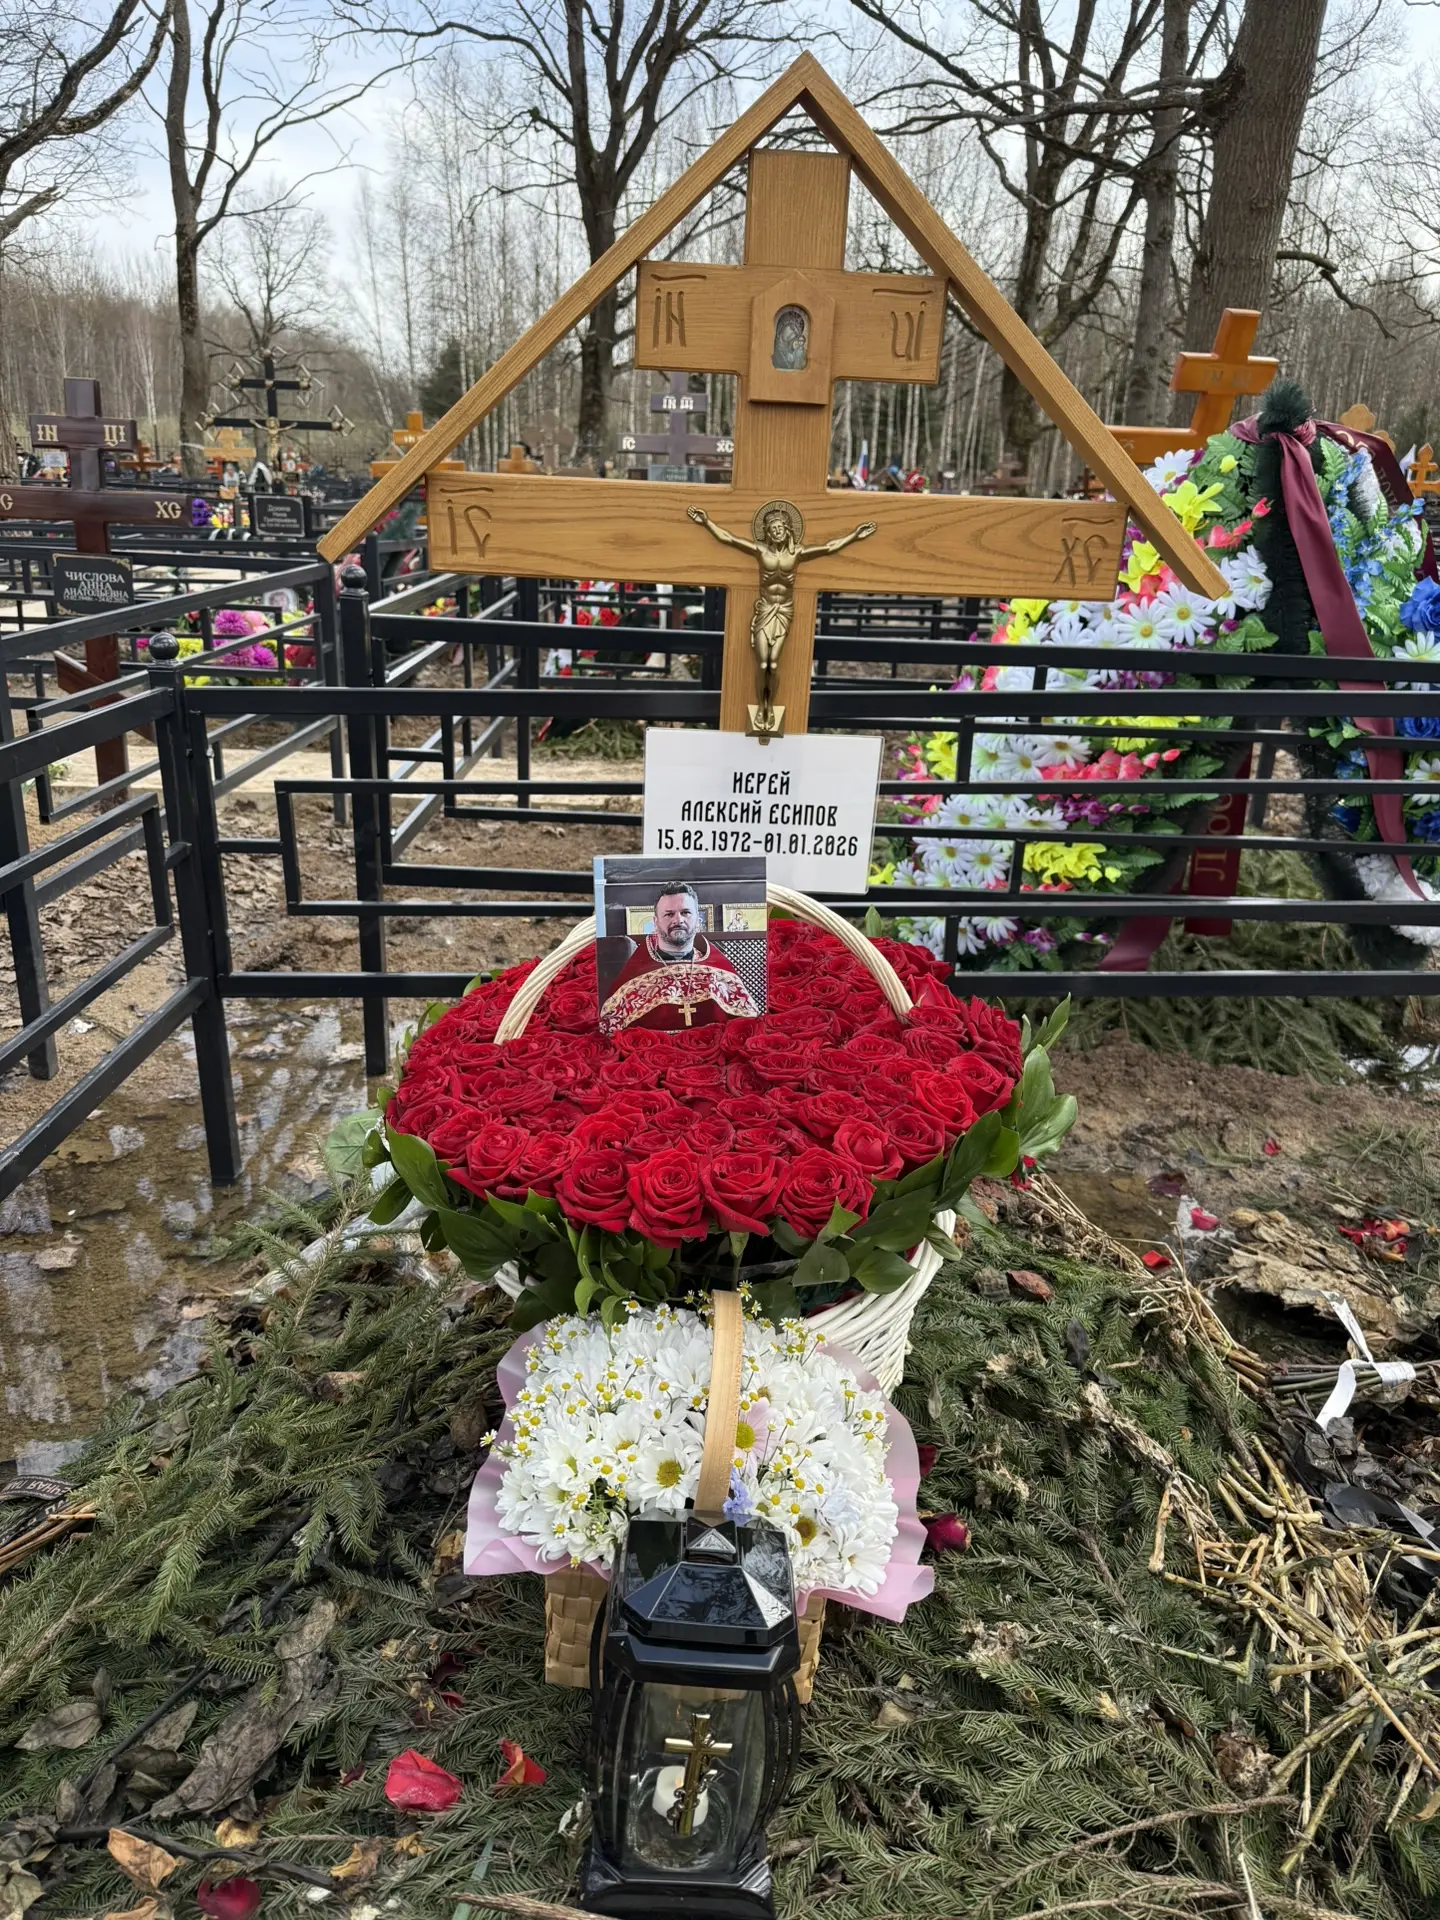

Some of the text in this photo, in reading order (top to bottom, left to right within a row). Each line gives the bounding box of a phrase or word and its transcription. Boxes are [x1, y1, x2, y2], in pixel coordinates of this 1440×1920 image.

[64, 570, 125, 584] ЧИСЛОВА
[79, 581, 113, 592] АННА
[732, 771, 791, 796] ИЕРЕЙ
[681, 800, 838, 827] АЛЕКСИЙ ЕСИПОВ
[657, 828, 859, 857] 15.02.1972-01.01.2026
